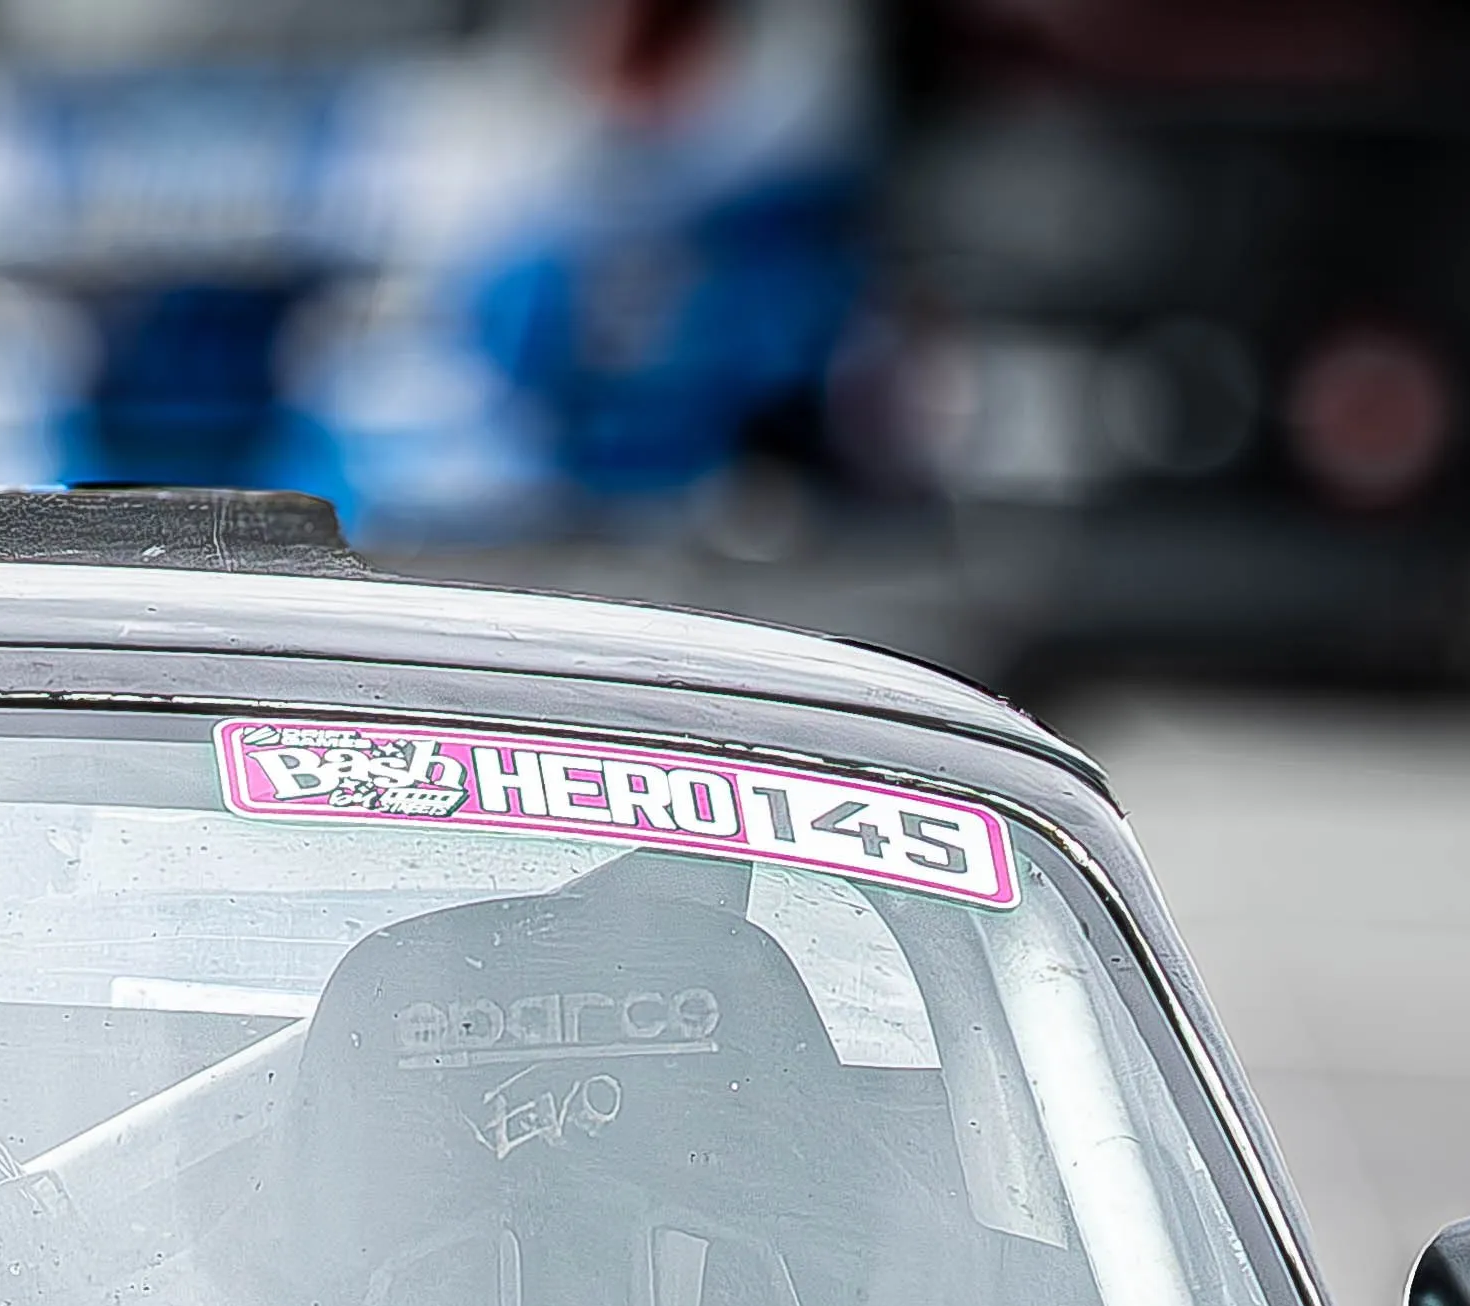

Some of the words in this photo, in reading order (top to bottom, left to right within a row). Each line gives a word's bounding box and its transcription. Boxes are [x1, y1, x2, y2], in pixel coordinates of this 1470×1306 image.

[246, 740, 468, 800] Bash
[472, 746, 744, 838] HERO
[751, 785, 969, 875] 145
